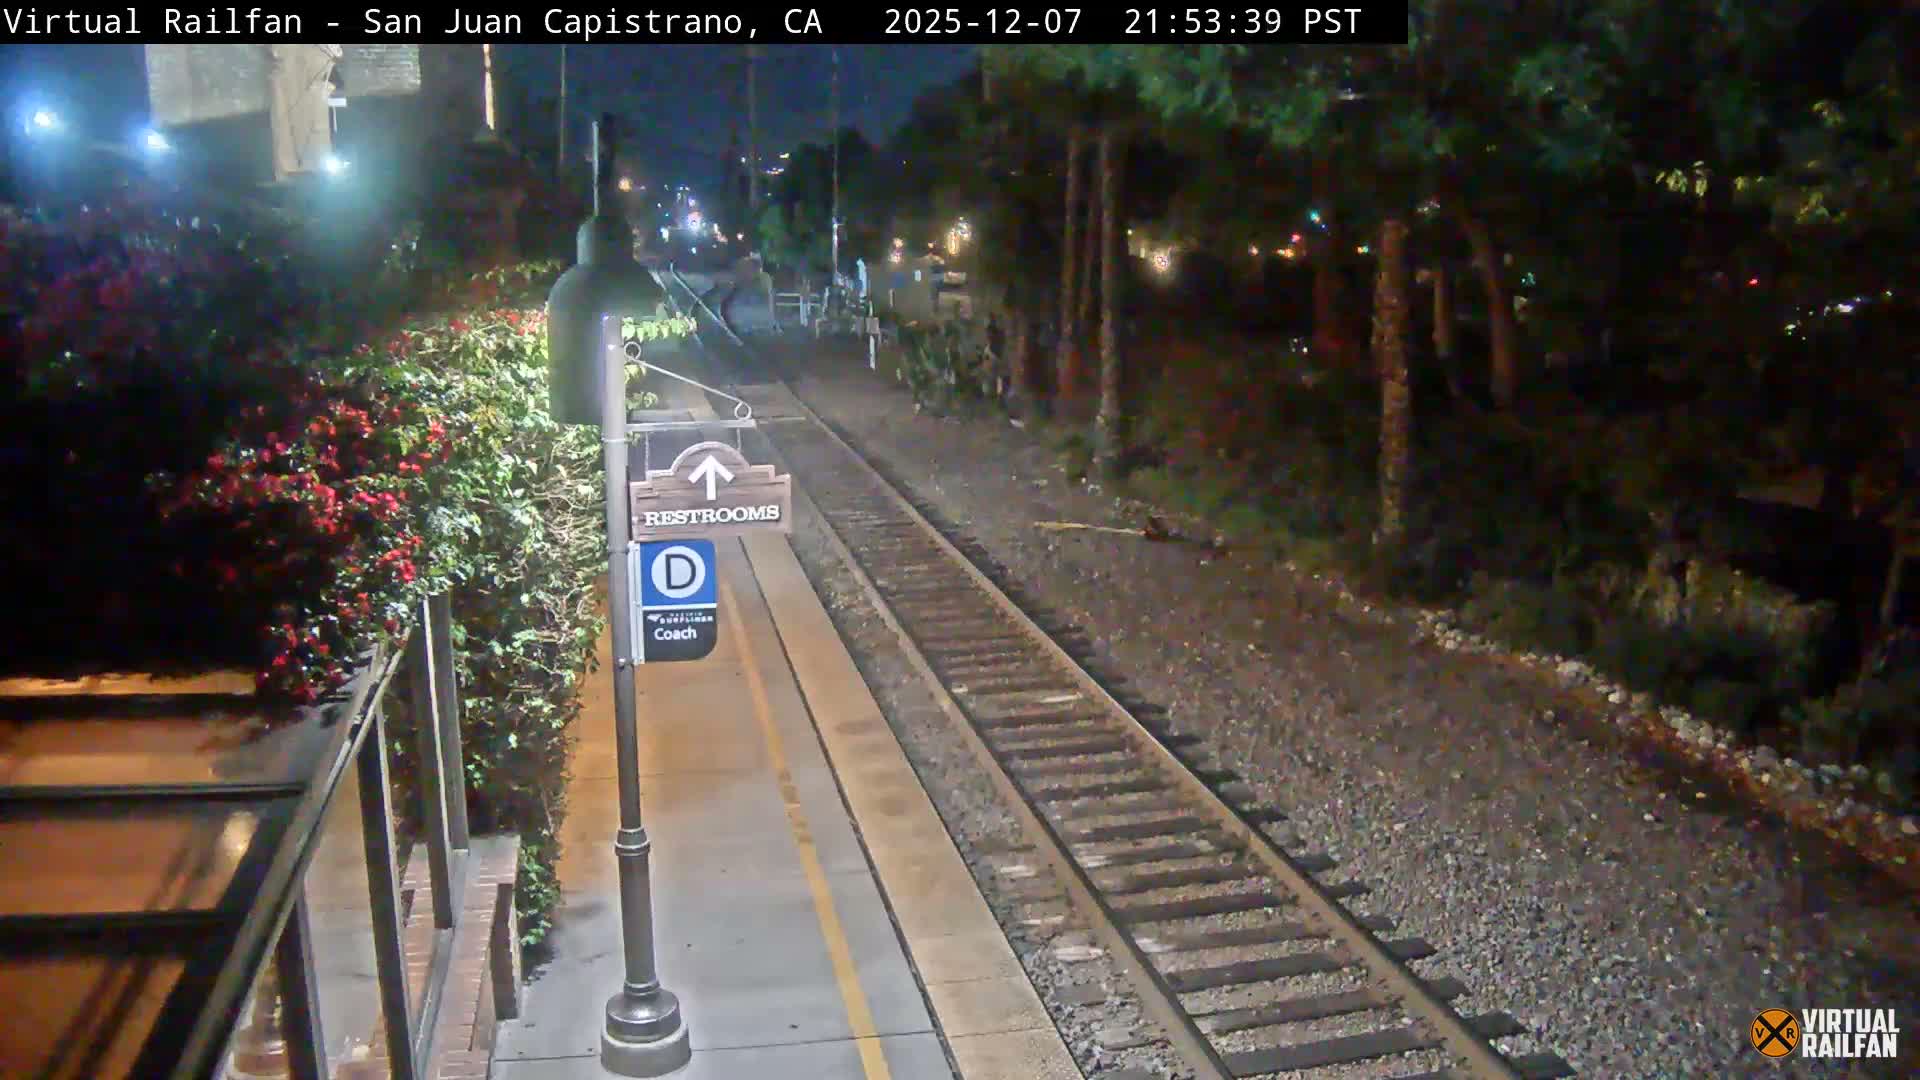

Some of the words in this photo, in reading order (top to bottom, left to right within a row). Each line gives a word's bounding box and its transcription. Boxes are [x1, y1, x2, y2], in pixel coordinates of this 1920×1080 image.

[644, 505, 780, 527] RESTROOMS
[665, 553, 696, 590] D
[654, 625, 697, 641] Coach
